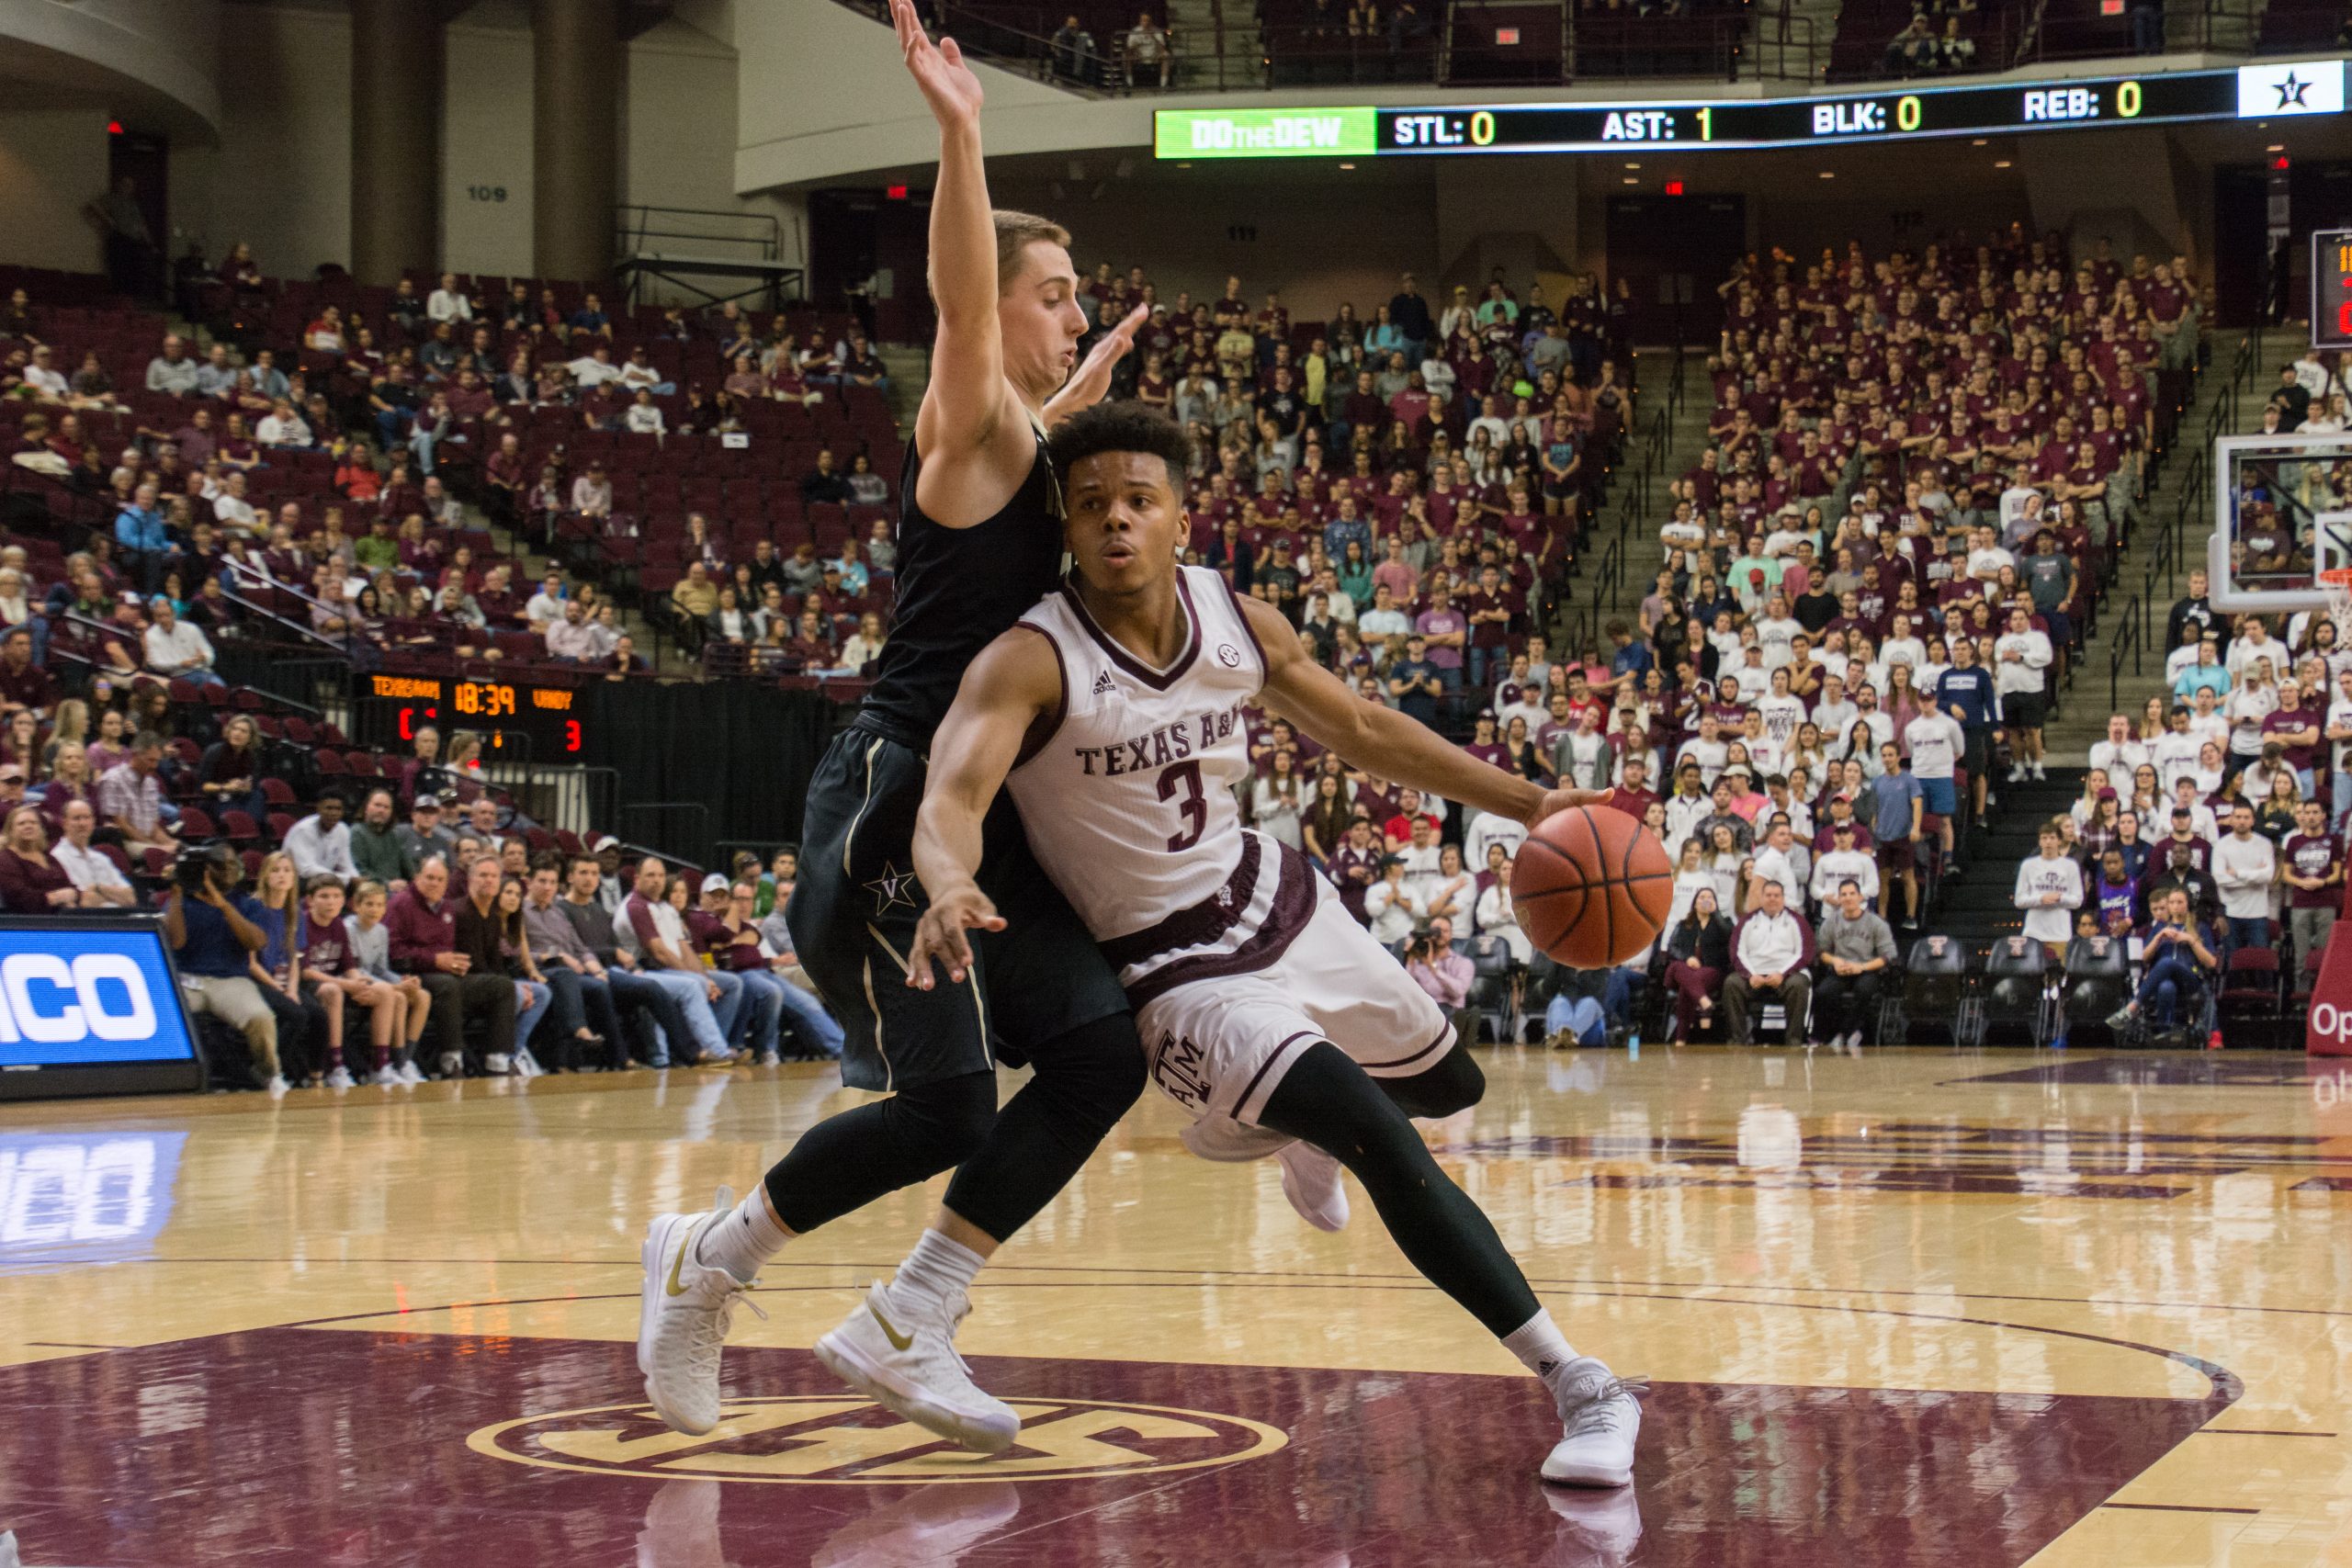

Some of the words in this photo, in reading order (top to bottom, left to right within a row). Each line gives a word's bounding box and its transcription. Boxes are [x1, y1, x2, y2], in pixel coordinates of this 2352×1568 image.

[1813, 102, 1885, 135] BLK:
[1897, 96, 1921, 131] 0
[2024, 88, 2099, 121] REB:
[2117, 81, 2143, 118] 0
[1395, 117, 1464, 145] STL:
[1471, 111, 1496, 146] 0
[1603, 112, 1675, 141] AST:
[1696, 107, 1712, 141] 1
[468, 186, 507, 202] 109
[455, 682, 515, 716] 18:39
[1092, 682, 1116, 695] adidas
[566, 720, 582, 751] 3
[1075, 719, 1191, 776] TEXAS
[1156, 760, 1207, 853] 3
[882, 878, 898, 899] V
